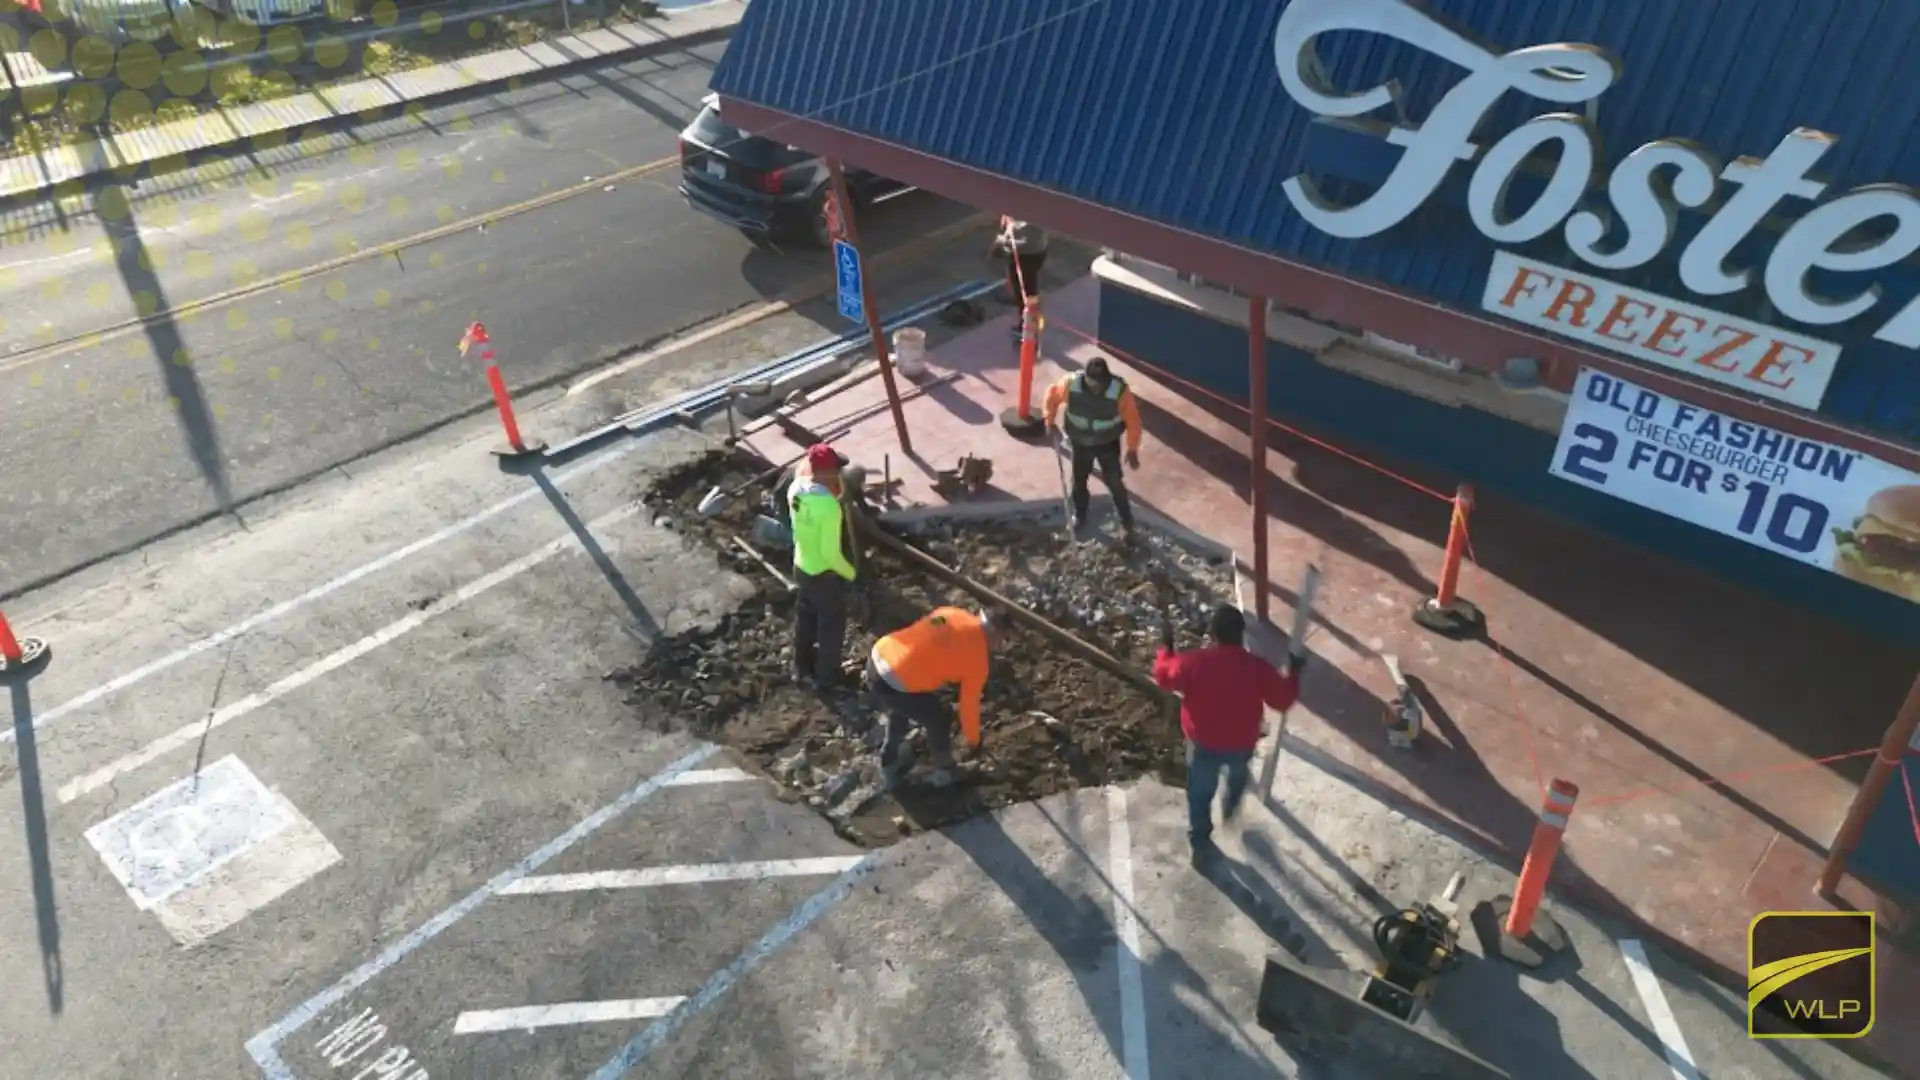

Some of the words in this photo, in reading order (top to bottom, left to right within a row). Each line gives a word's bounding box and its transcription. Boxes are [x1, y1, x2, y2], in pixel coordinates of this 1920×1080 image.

[1500, 265, 1816, 392] FREEZE
[1562, 422, 1618, 484] 2
[1627, 440, 1712, 494] FOR
[1586, 373, 1660, 420] OLD
[1673, 403, 1854, 482] FASHION
[1624, 413, 1789, 485] CHEESEBURGER
[315, 1006, 388, 1068] NO
